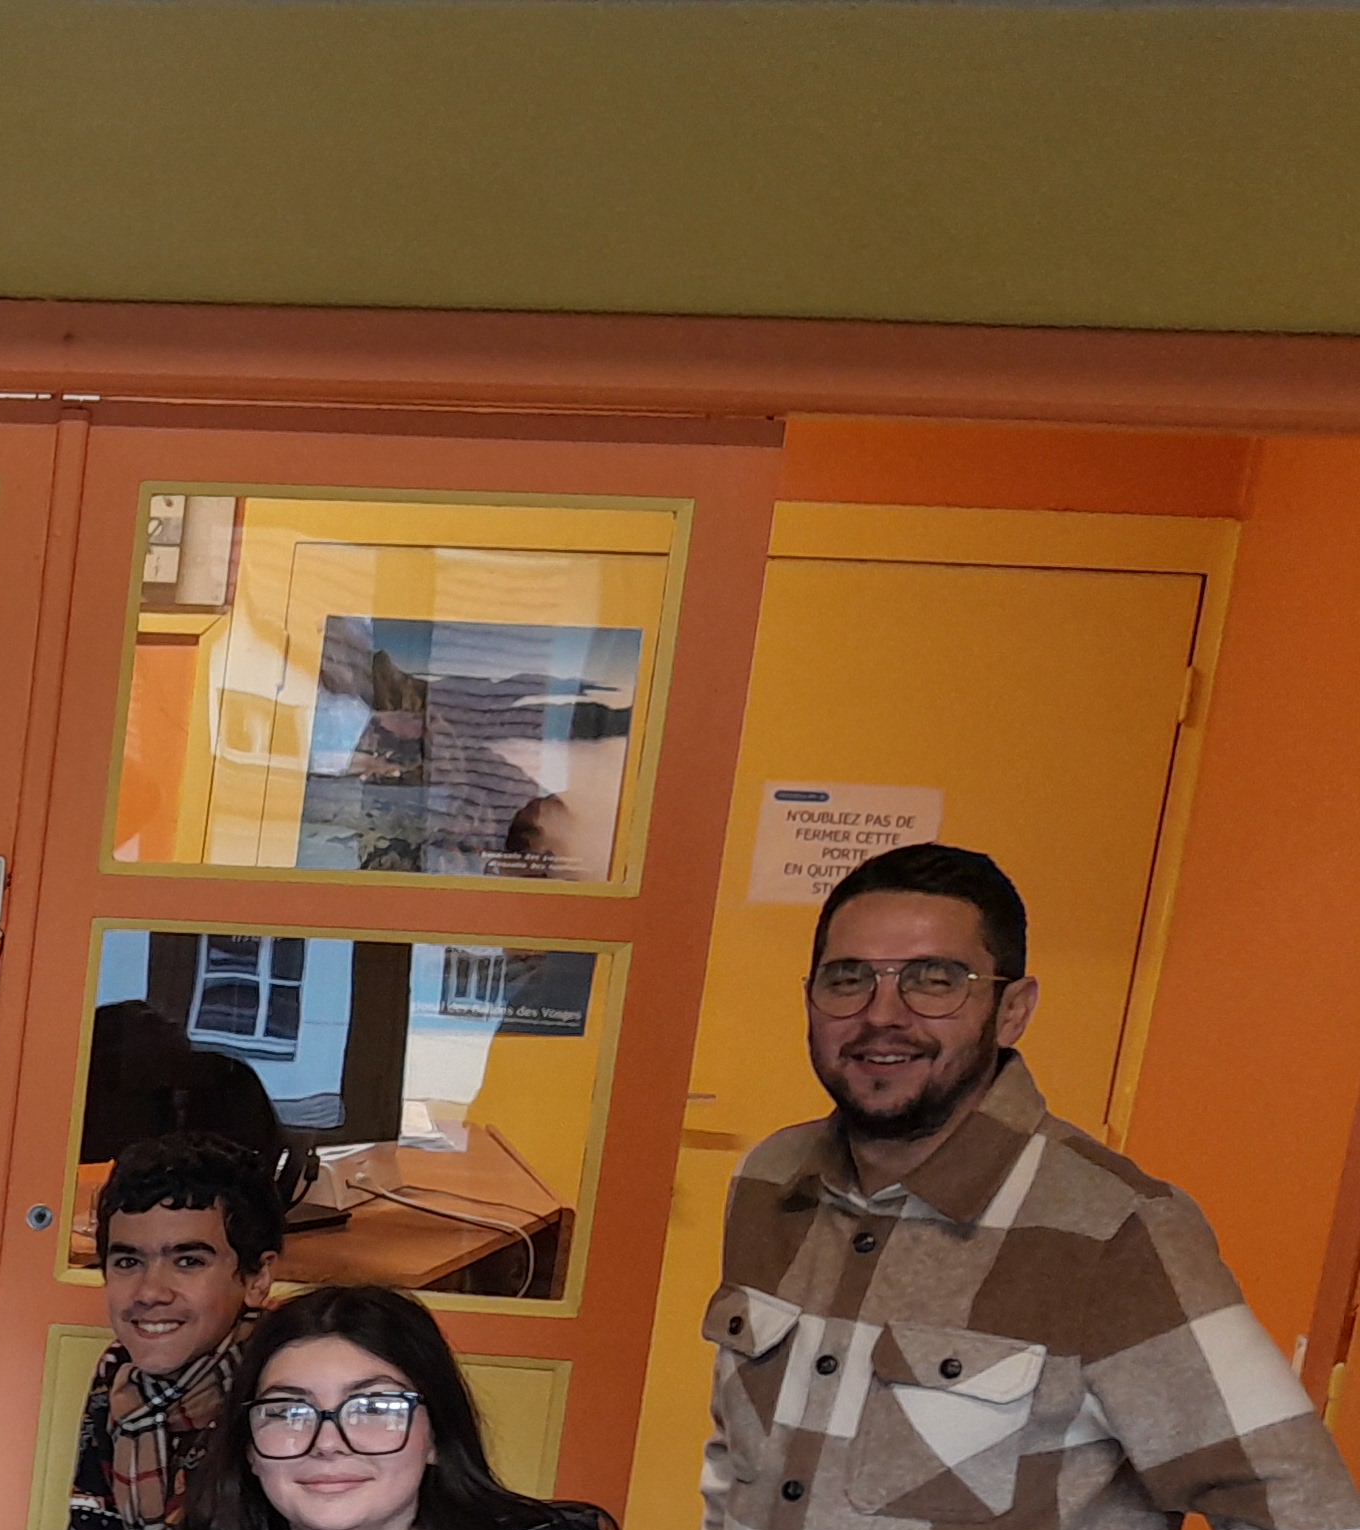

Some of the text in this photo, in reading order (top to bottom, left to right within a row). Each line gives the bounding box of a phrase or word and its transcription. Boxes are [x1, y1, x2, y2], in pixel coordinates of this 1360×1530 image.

[786, 809, 917, 829] N'OUBLIEZ PAS DE
[795, 828, 902, 845] FERMER CETTE
[821, 847, 868, 860] PORTE
[784, 862, 802, 875] EN
